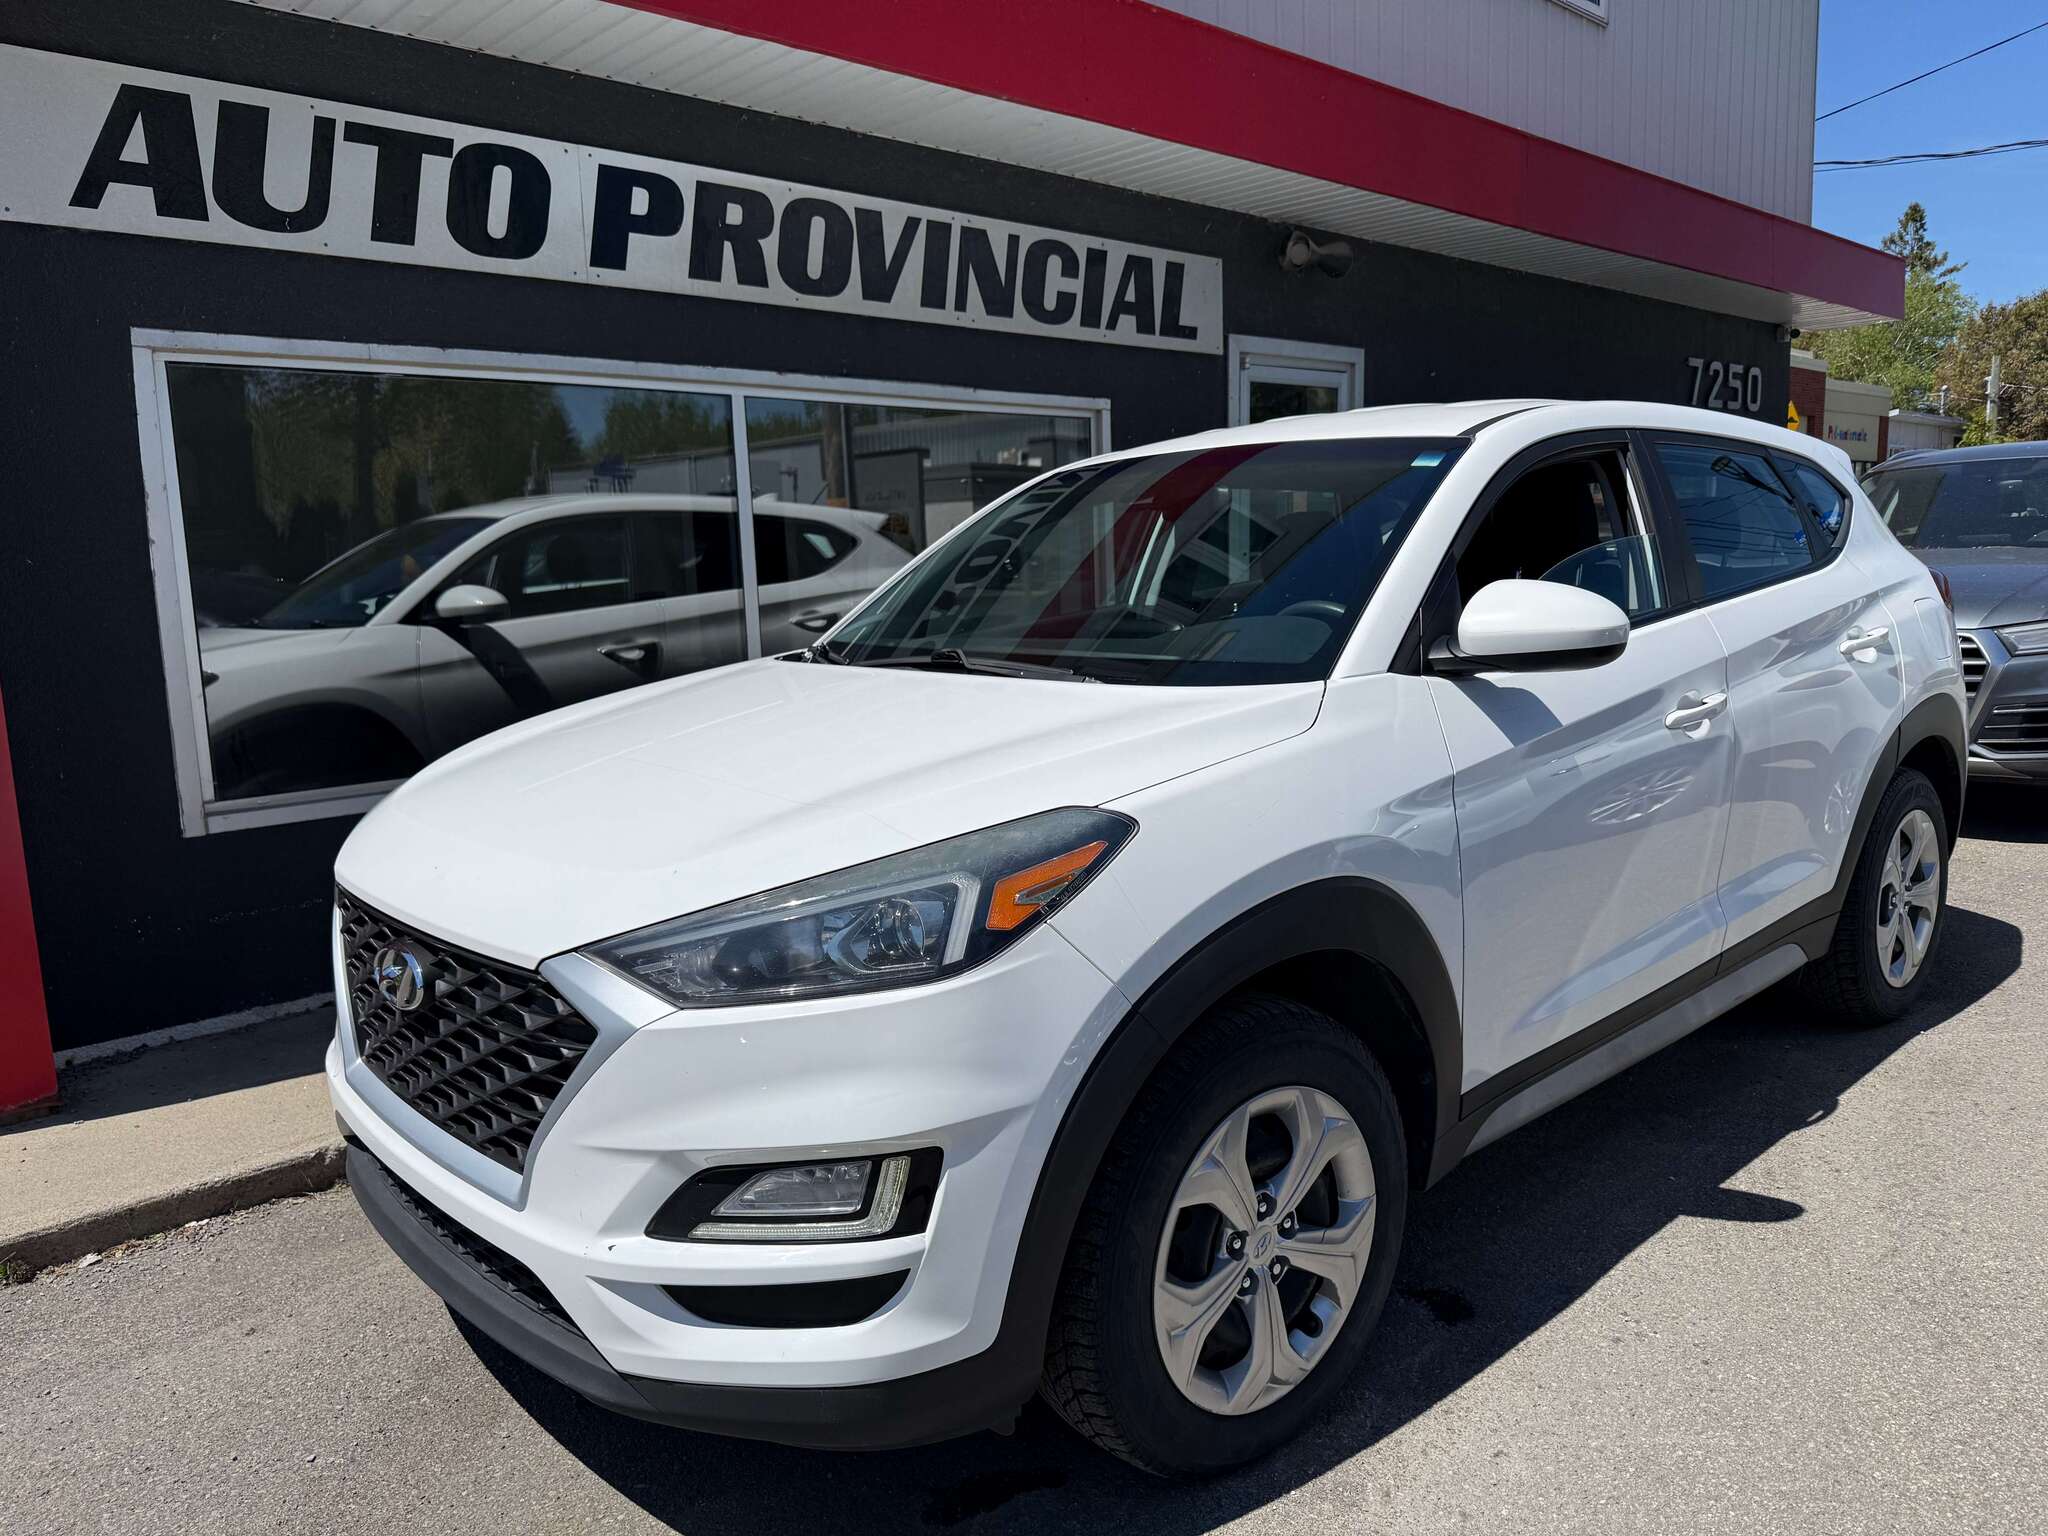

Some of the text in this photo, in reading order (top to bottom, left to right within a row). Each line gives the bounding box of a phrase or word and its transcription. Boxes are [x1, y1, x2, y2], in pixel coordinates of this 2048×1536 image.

[68, 83, 1198, 340] AUTO PROVINCIAL
[1687, 357, 1762, 412] 7250
